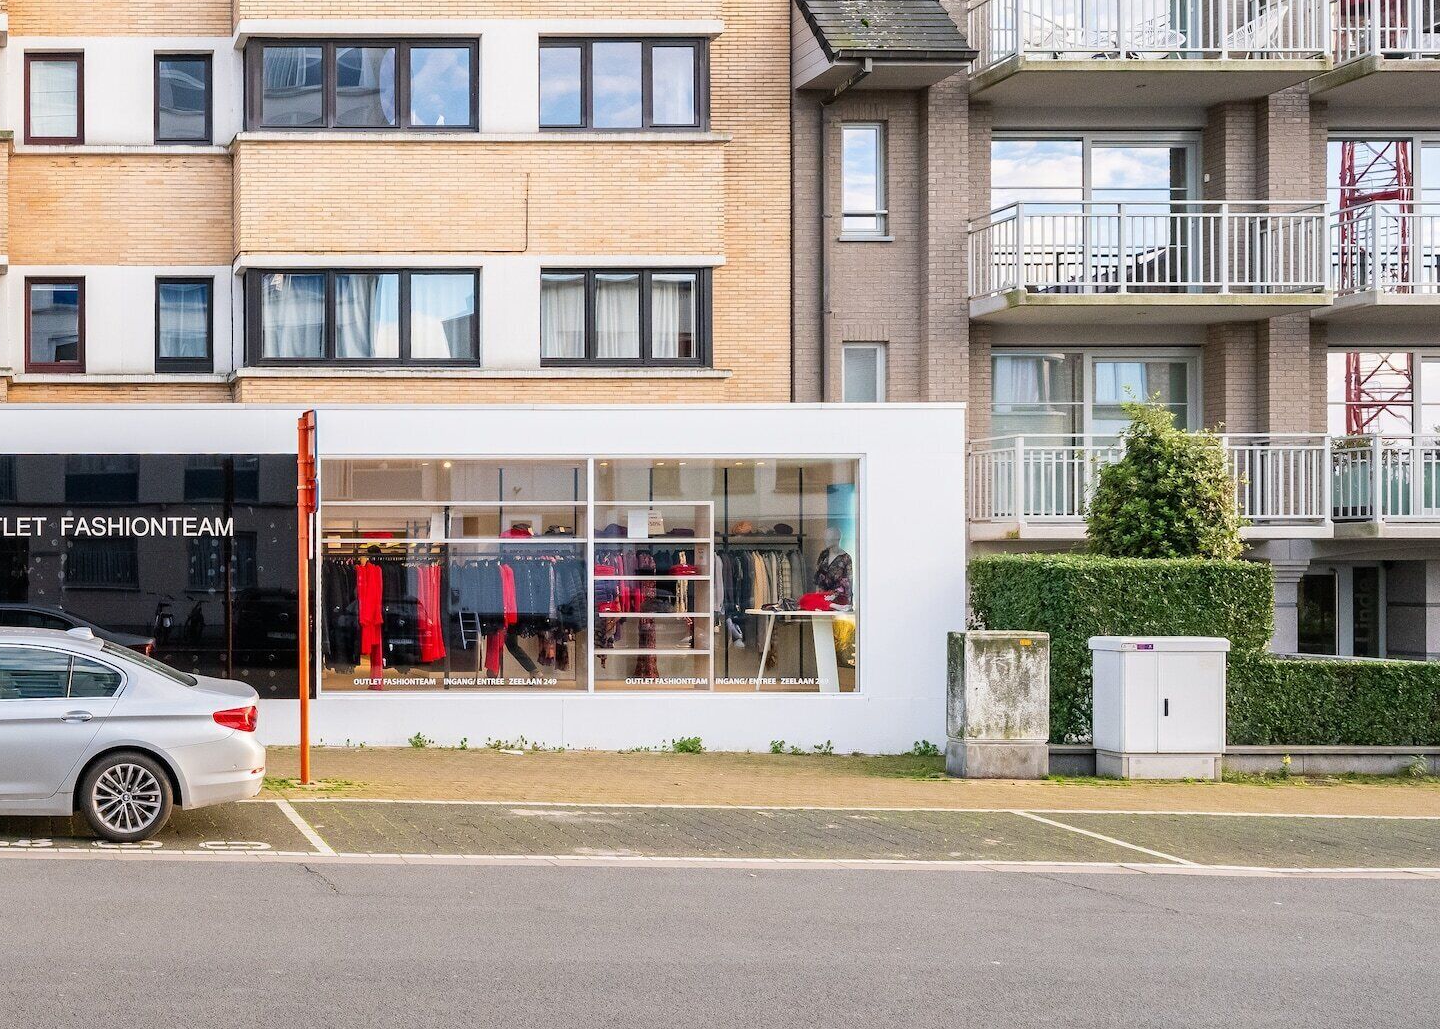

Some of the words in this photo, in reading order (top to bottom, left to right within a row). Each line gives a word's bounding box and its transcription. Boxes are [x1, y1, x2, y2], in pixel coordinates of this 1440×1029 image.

[60, 517, 235, 537] FASHIONTEAM
[353, 678, 382, 686] OUTLET
[383, 678, 436, 686] FASHIONTEAM
[625, 677, 654, 685] OUTLET
[655, 677, 707, 685] FASHIONTEAM
[780, 677, 814, 685] ZEELAAN
